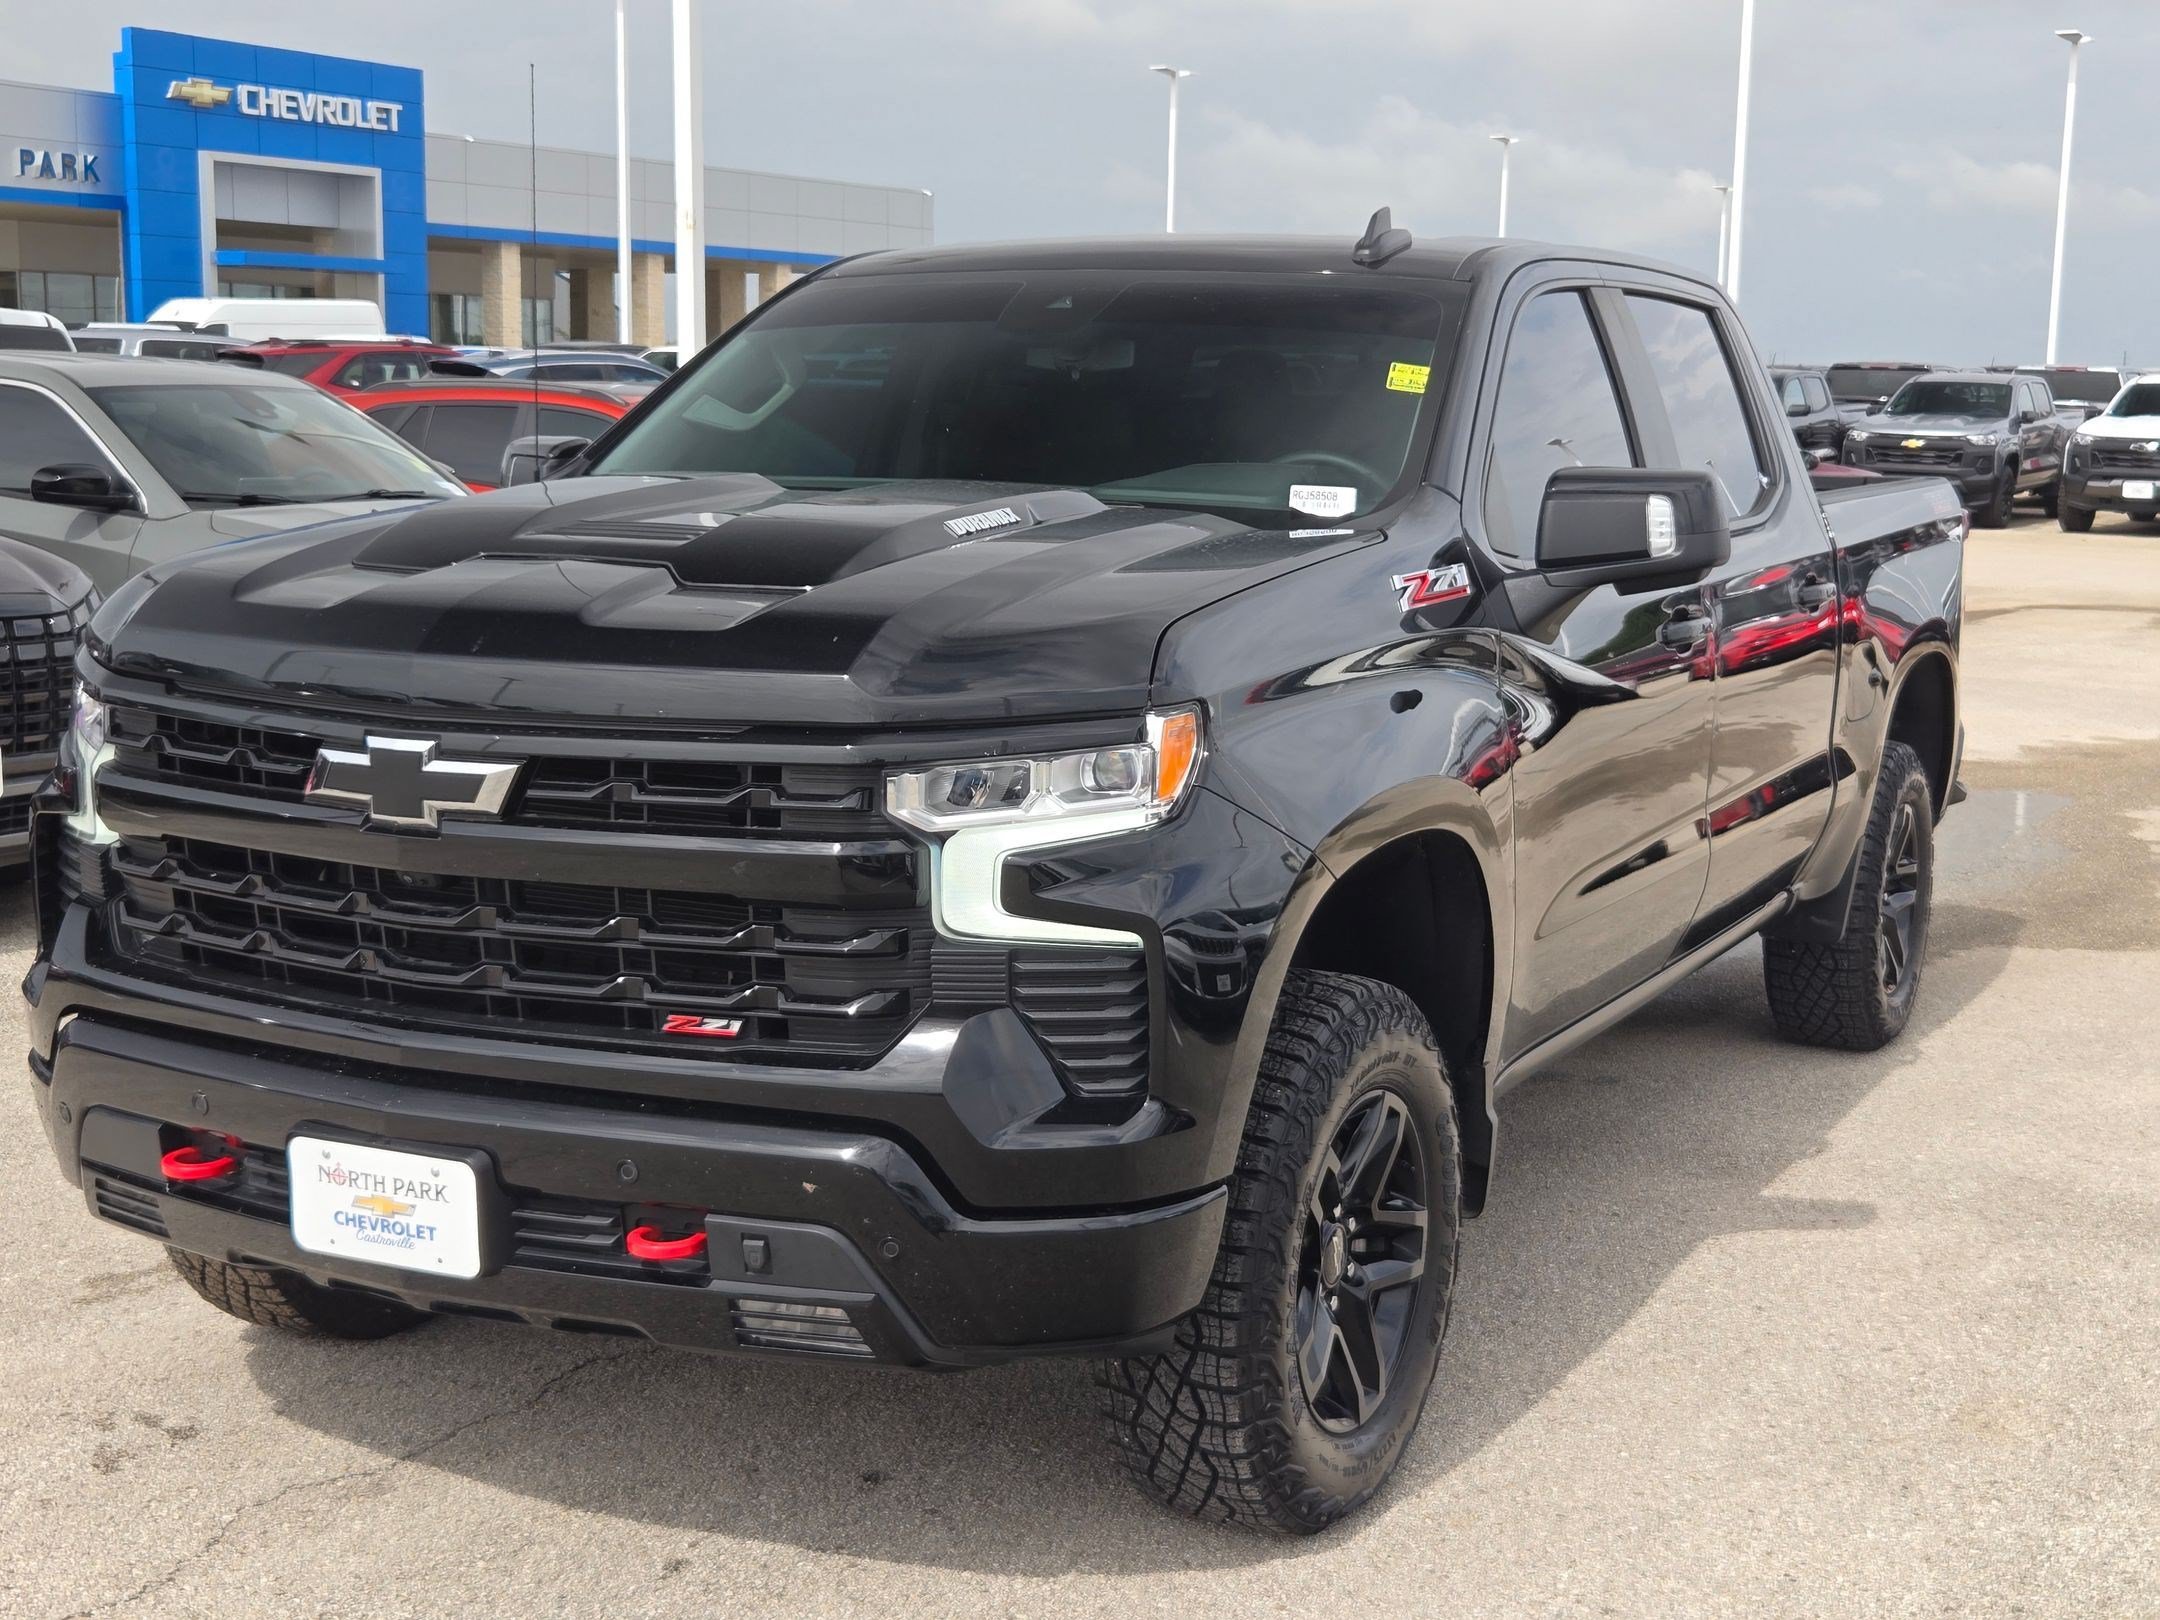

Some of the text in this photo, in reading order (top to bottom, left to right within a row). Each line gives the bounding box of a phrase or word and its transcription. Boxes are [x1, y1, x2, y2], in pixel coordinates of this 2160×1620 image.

[237, 83, 403, 132] CHEVROLET
[16, 147, 100, 183] PARK
[943, 507, 1021, 538] DURAMAX
[1390, 563, 1471, 613] Z71
[662, 1014, 743, 1038] Z71
[318, 1162, 450, 1203] NORTH PARK
[334, 1210, 437, 1241] CHEVROLET
[356, 1229, 417, 1250] Castroville
